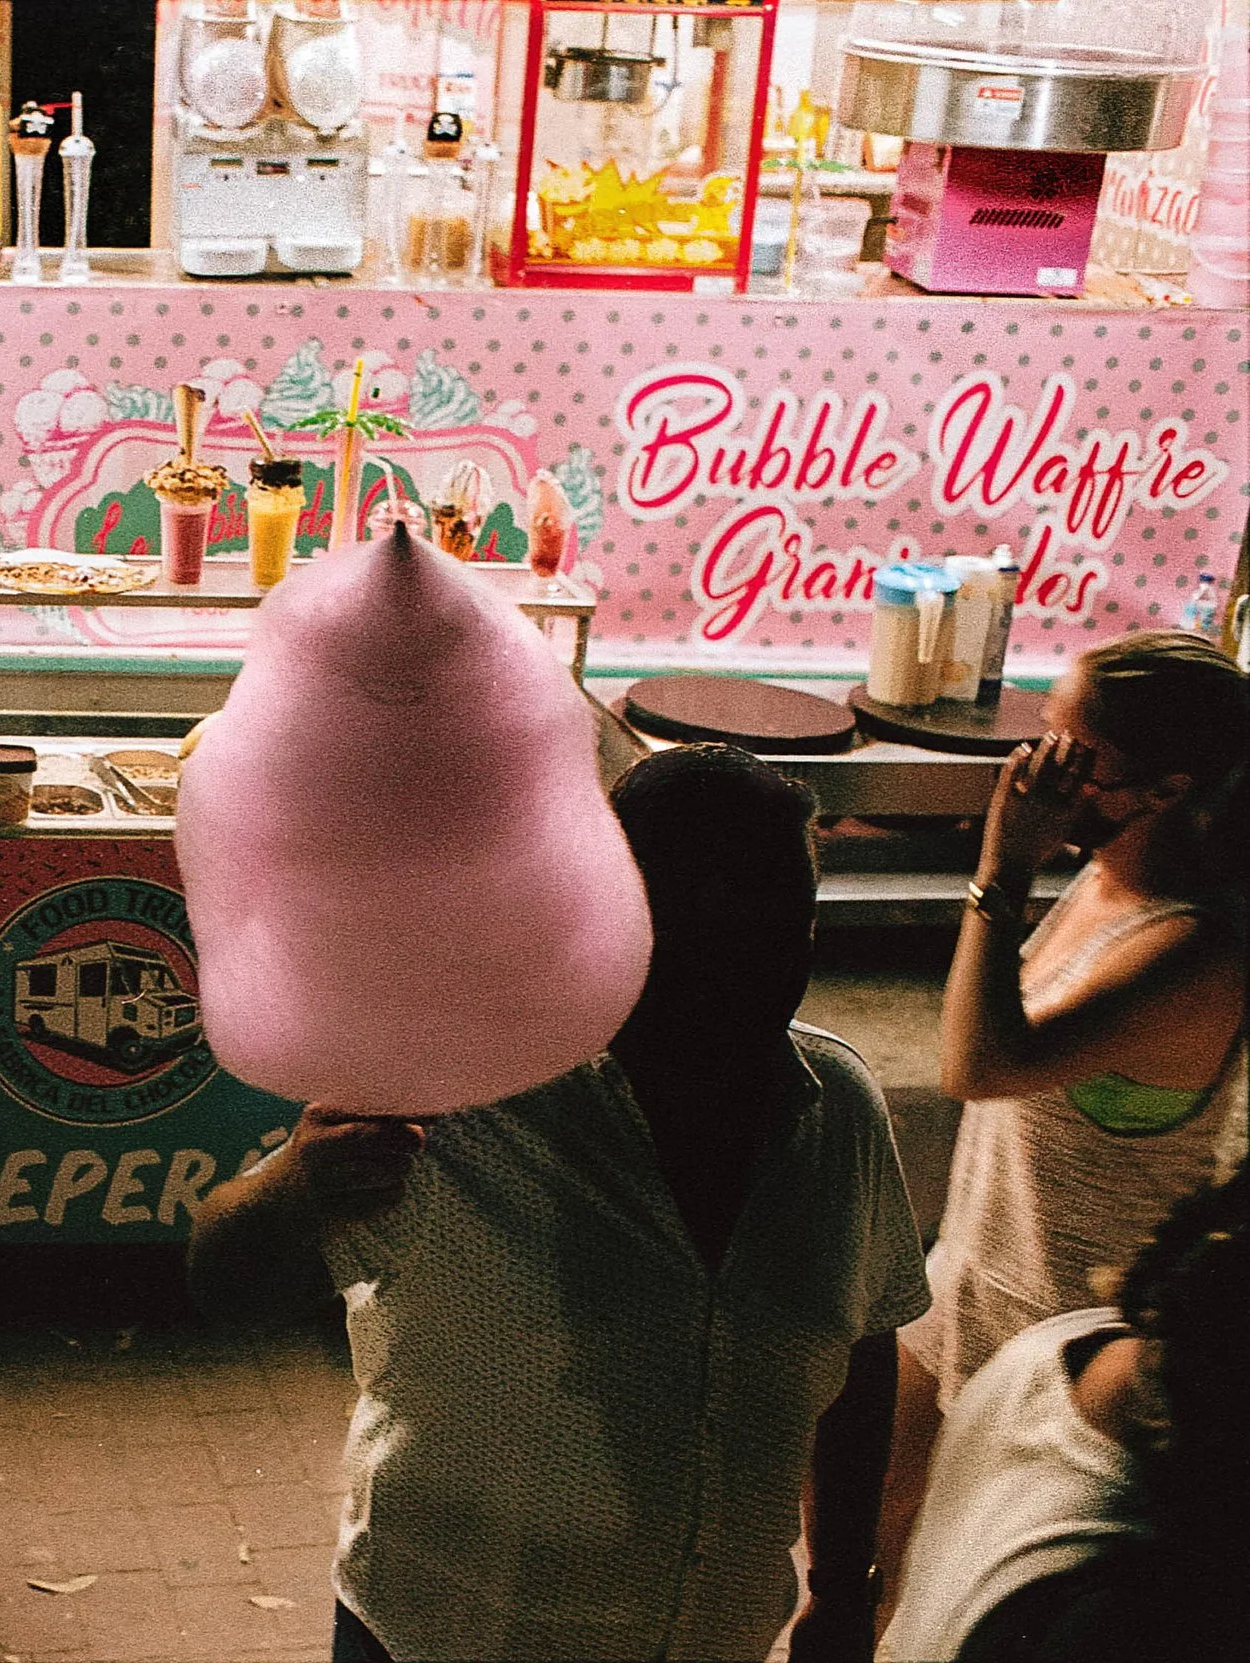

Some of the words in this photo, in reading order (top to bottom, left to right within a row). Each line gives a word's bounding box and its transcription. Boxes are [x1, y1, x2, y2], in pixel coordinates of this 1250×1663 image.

[626, 374, 908, 508] Bubble
[701, 504, 1098, 641] Grandos
[20, 887, 107, 941] FOOD
[124, 886, 194, 948] TRUC
